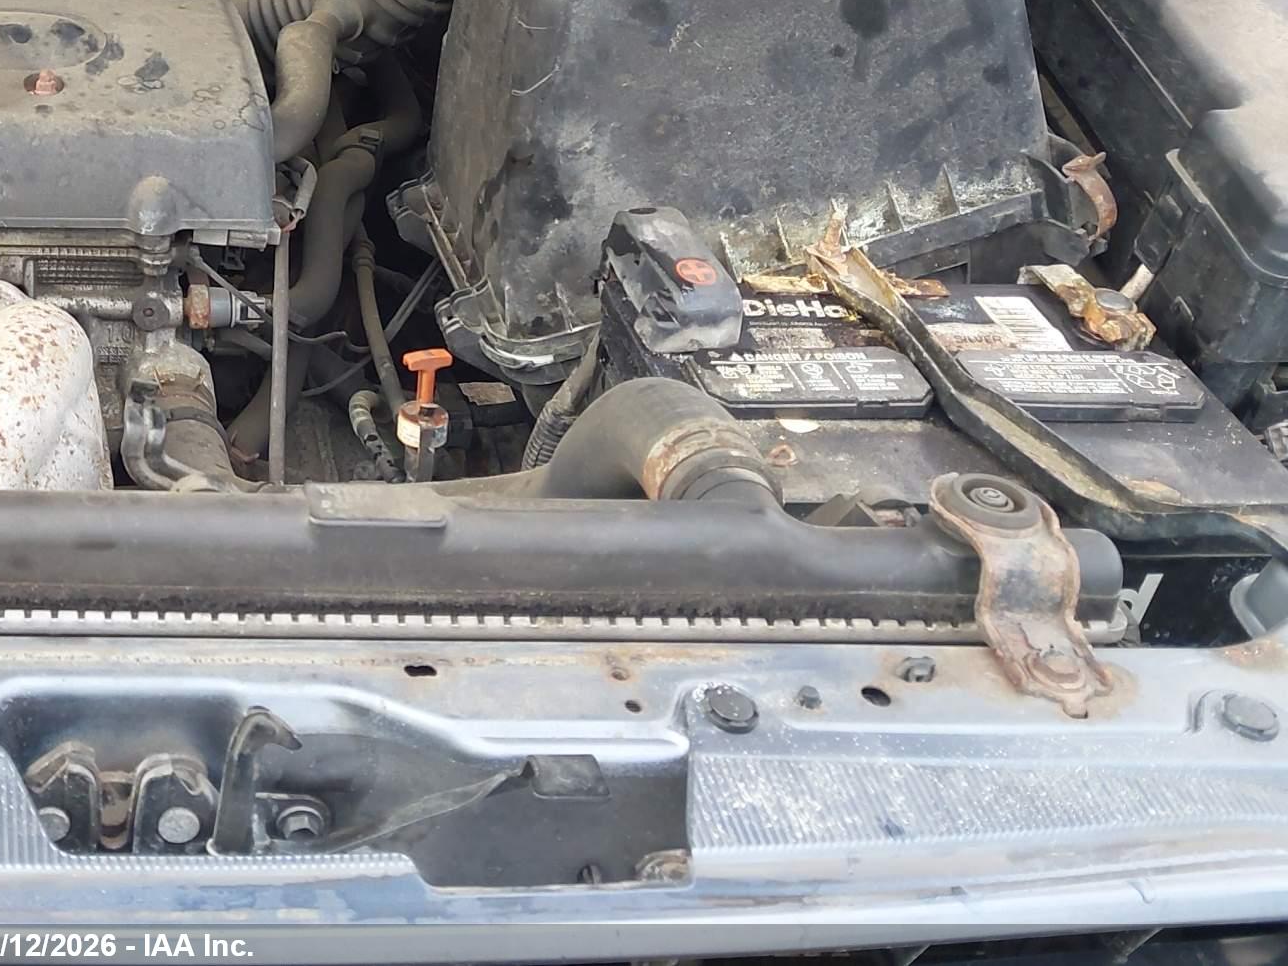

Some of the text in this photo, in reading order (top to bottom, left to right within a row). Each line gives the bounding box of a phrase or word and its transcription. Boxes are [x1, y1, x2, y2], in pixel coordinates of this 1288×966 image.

[742, 298, 849, 318] DieHa
[954, 334, 1003, 345] SILVER
[743, 352, 801, 361] DANGER
[814, 352, 867, 361] POISON
